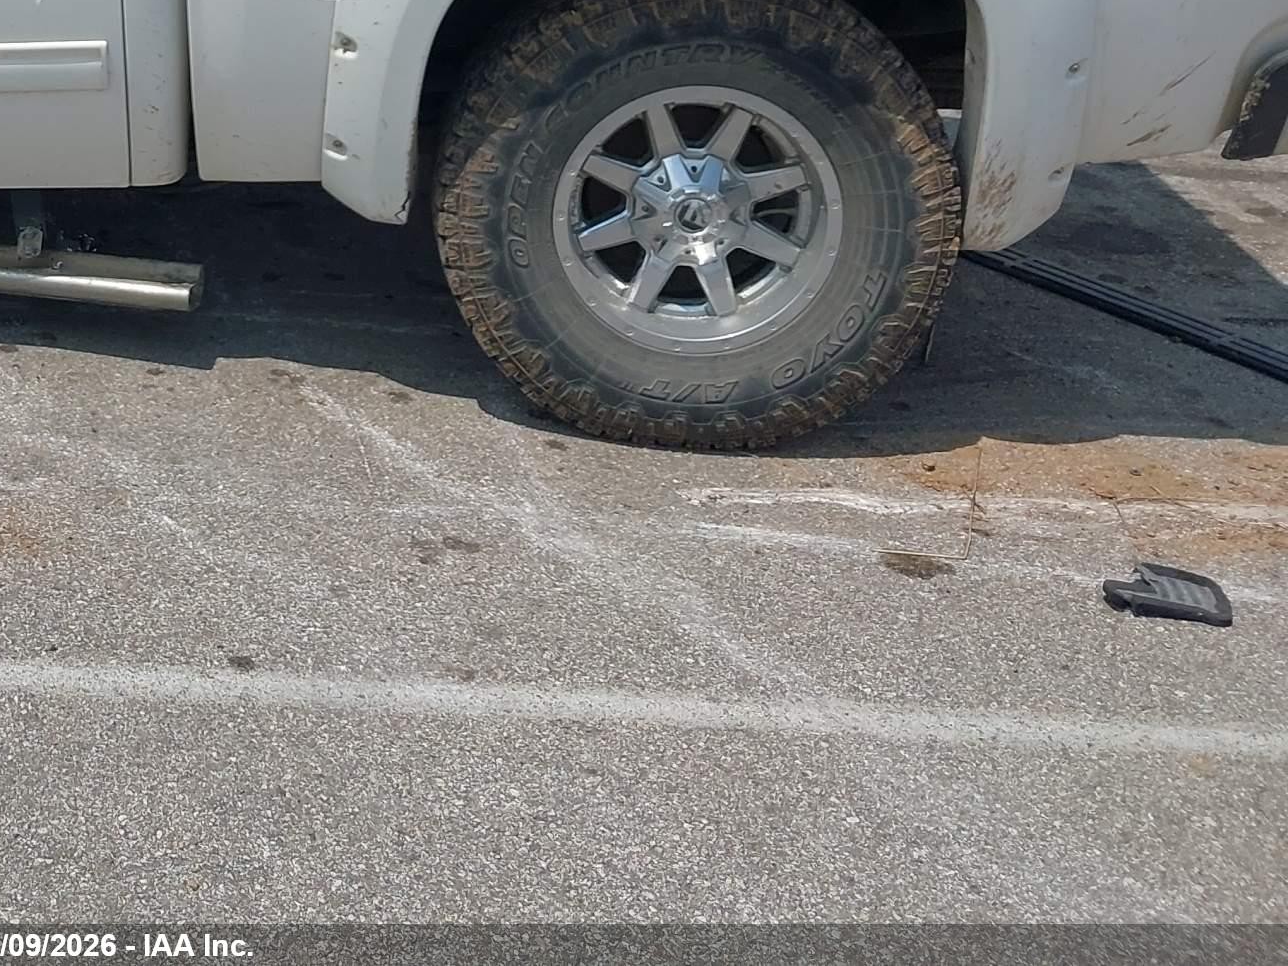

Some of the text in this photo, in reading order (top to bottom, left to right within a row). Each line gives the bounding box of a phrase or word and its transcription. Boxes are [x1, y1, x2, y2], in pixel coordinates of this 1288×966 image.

[507, 142, 552, 269] OPEN
[545, 42, 766, 129] COUNTRY
[770, 272, 888, 390] TOYO
